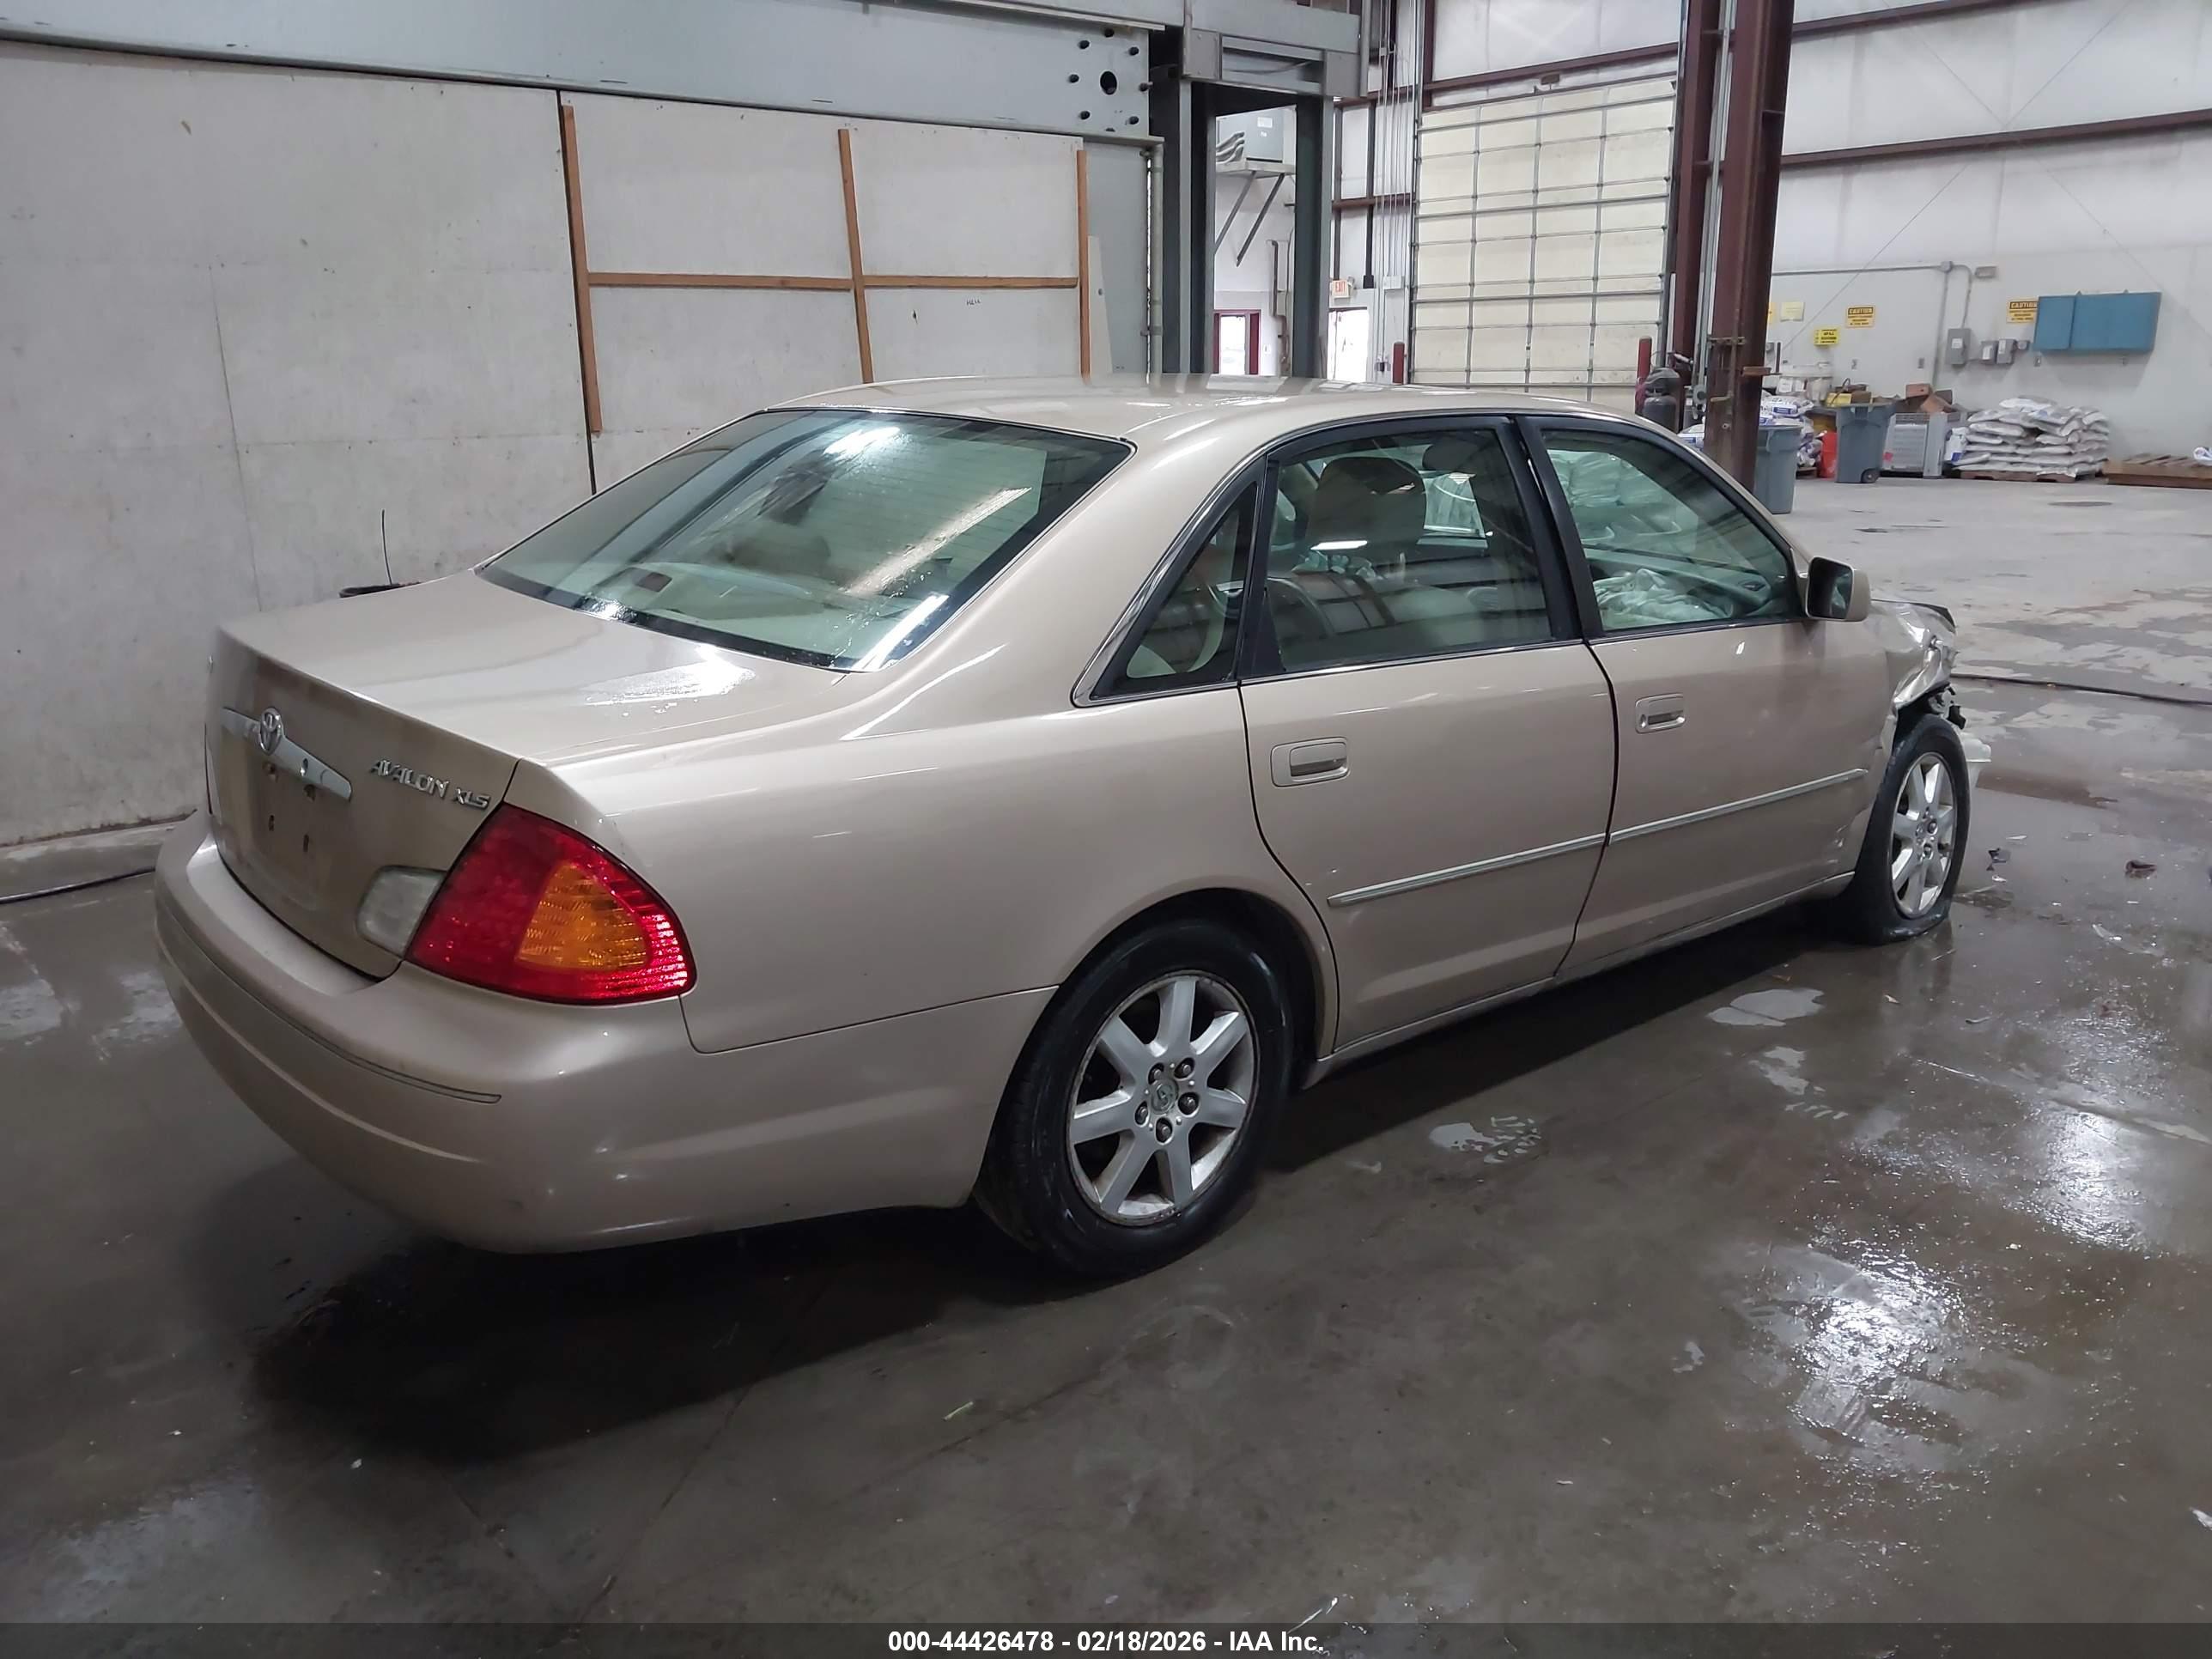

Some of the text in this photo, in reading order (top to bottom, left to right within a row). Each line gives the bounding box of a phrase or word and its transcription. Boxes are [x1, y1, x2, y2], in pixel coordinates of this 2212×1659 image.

[1335, 281, 1346, 293] EXIT
[370, 760, 490, 808] AVALON XLS
